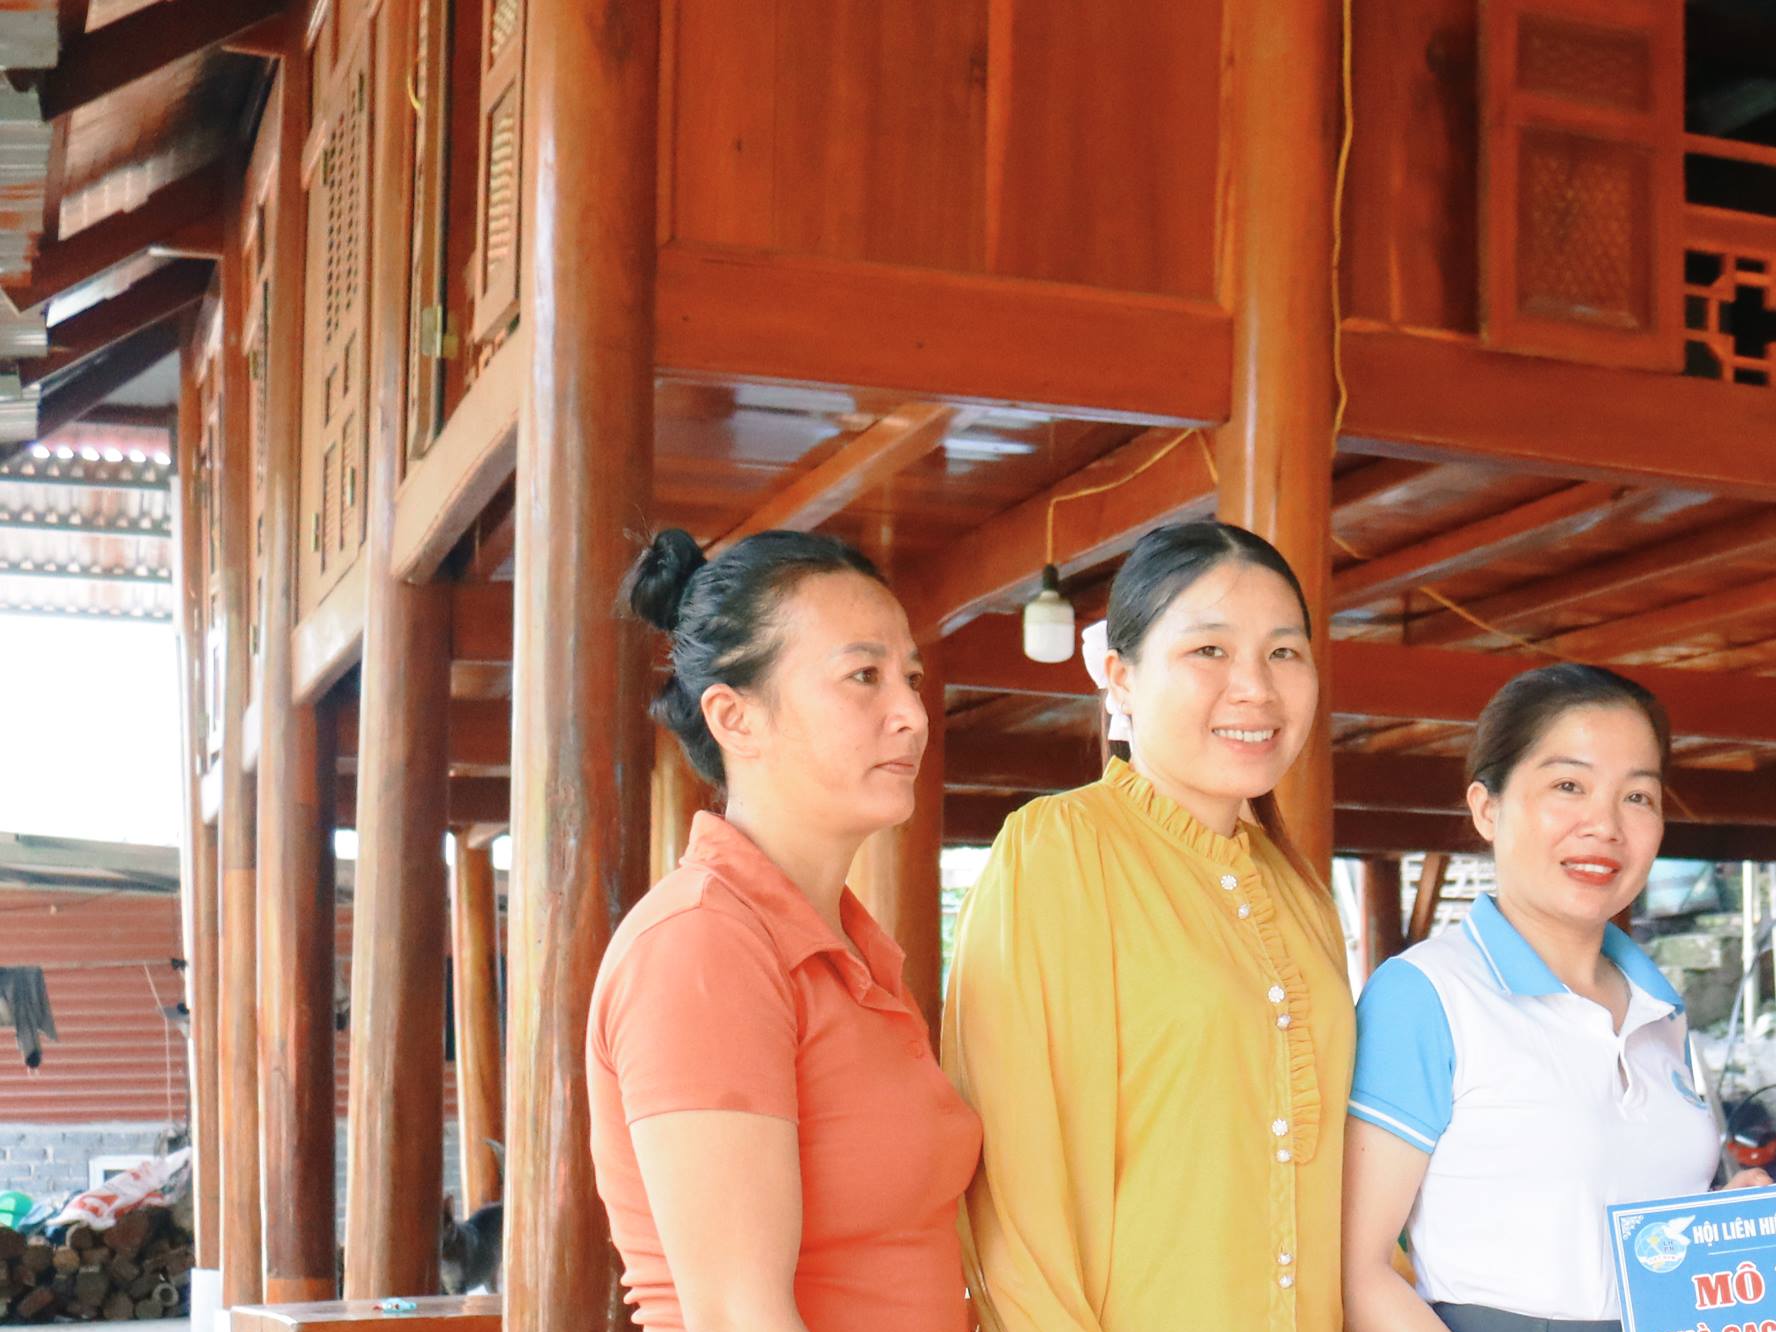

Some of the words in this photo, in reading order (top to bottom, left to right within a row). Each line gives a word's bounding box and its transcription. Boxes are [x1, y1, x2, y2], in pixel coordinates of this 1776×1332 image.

[1692, 1220, 1719, 1246] HỘI
[1722, 1217, 1756, 1240] LIÊN
[1692, 1262, 1765, 1309] MÔ
